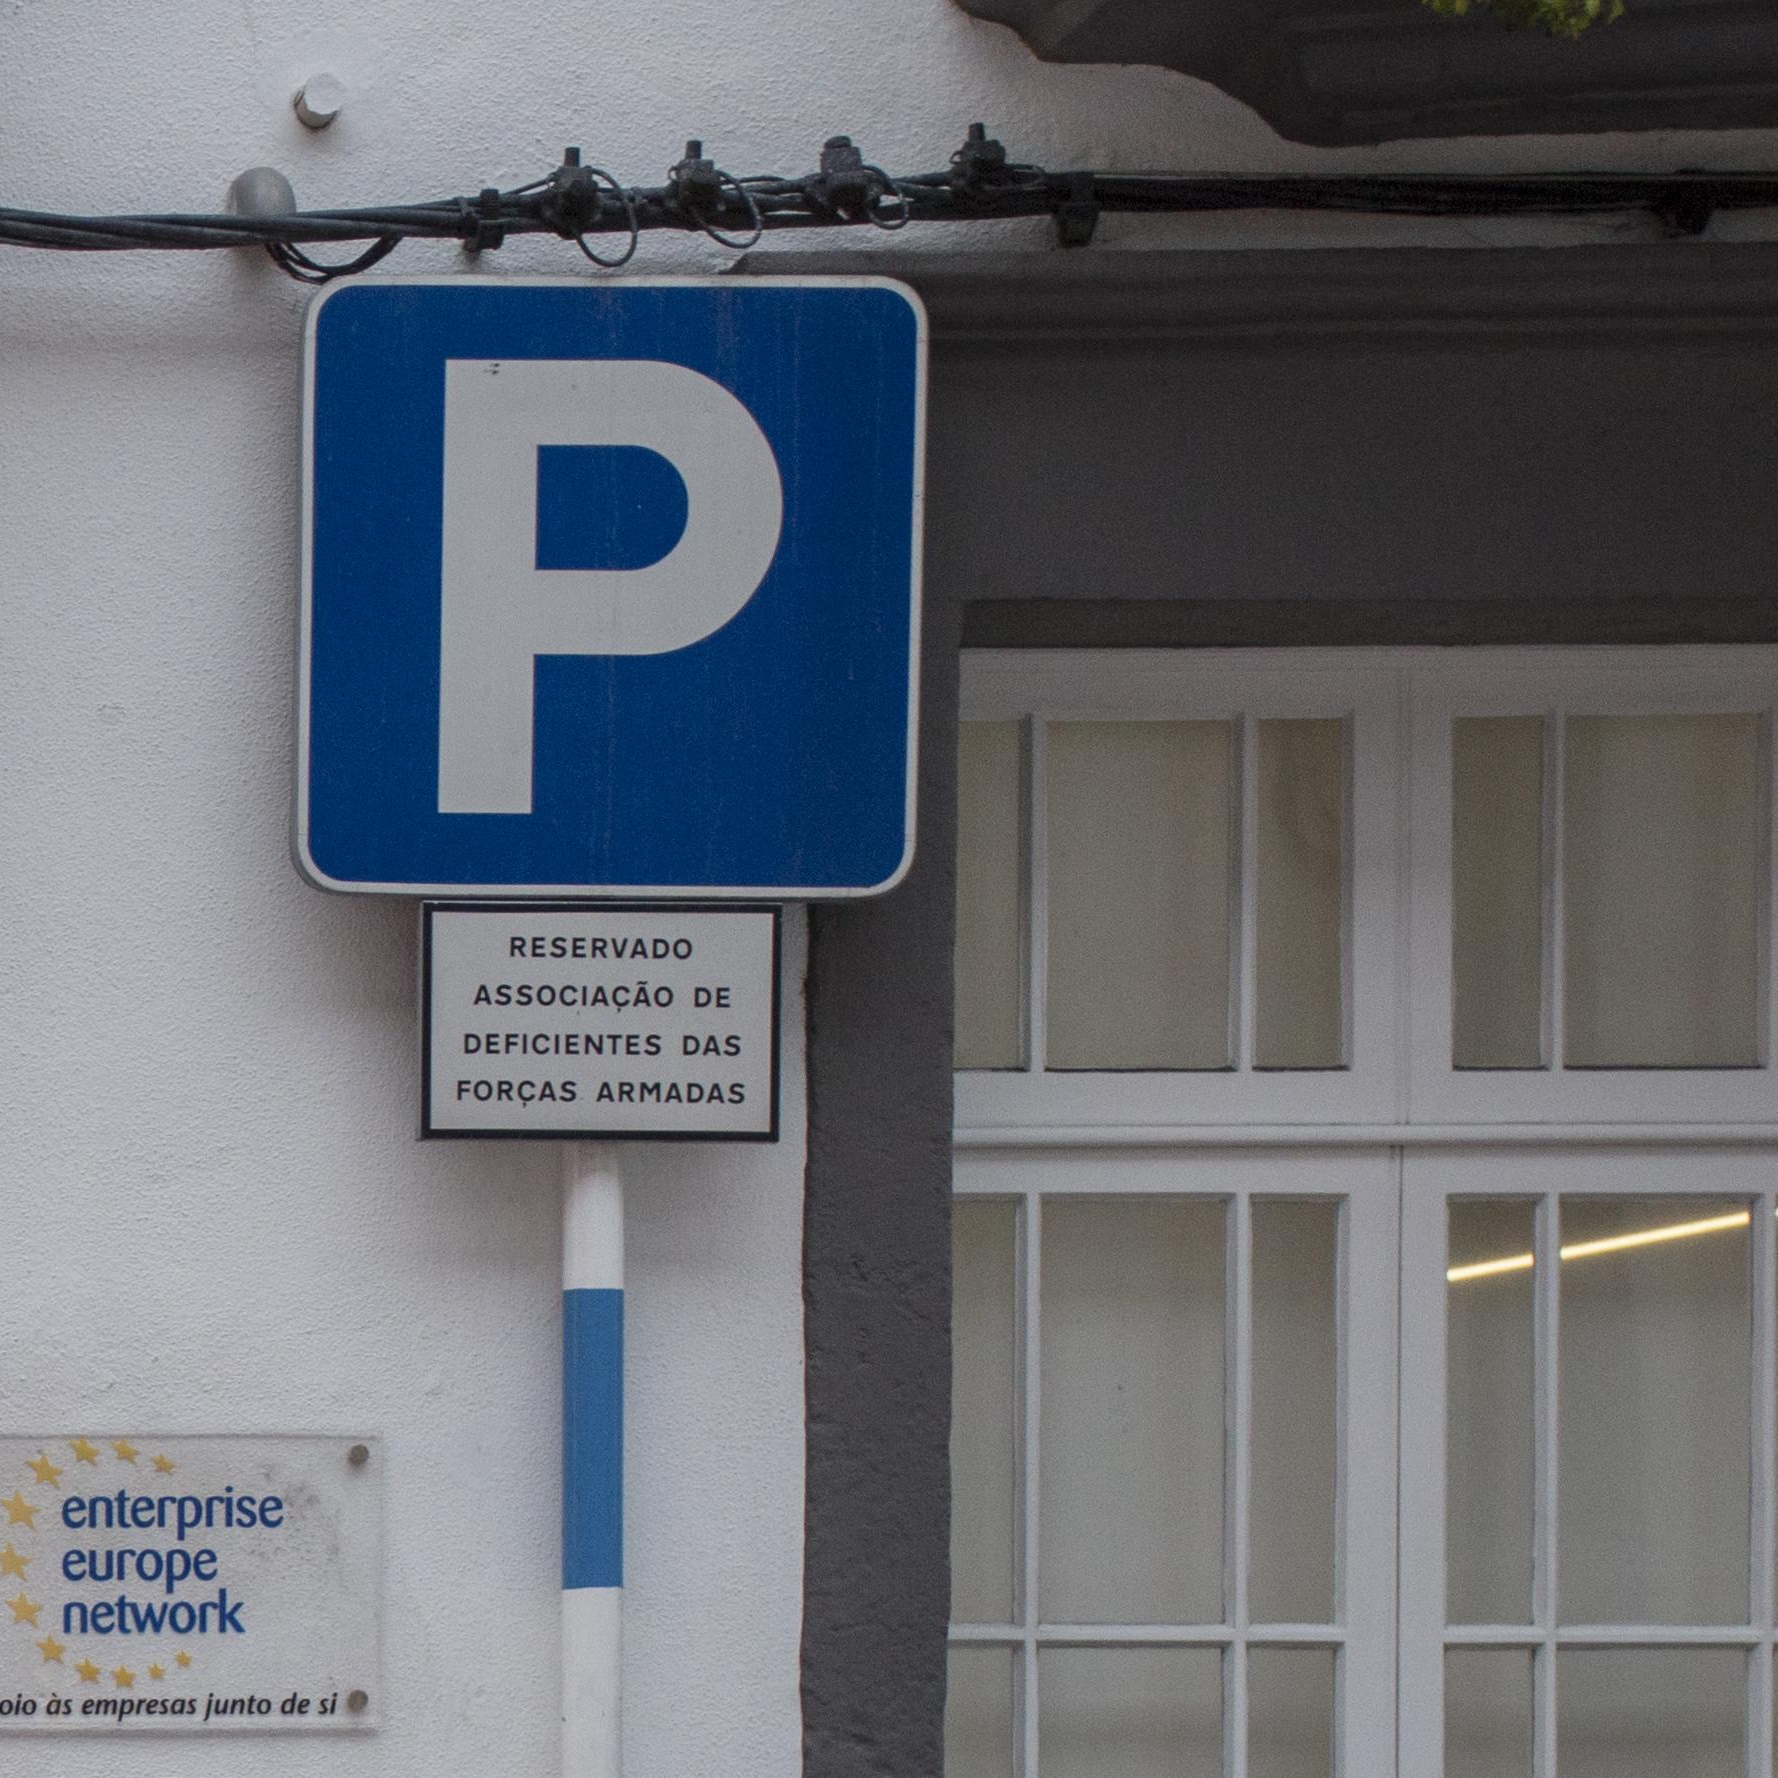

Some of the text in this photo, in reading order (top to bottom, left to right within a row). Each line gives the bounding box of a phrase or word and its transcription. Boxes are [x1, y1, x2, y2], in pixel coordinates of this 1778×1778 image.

[438, 359, 783, 814] P
[509, 936, 693, 959] RESERVADO
[473, 981, 731, 1013] ASSOCIAÇÃO DE
[463, 1033, 741, 1056] DEFICIENTES DAS
[457, 1080, 746, 1108] FORÇAS ARMADAS
[61, 1486, 284, 1540] enterprise
[61, 1547, 218, 1593] europe
[63, 1588, 245, 1634] network
[46, 1691, 73, 1716] às
[81, 1696, 197, 1722] empresas
[203, 1693, 273, 1722] junto
[281, 1693, 310, 1715] de
[318, 1693, 338, 1715] si
